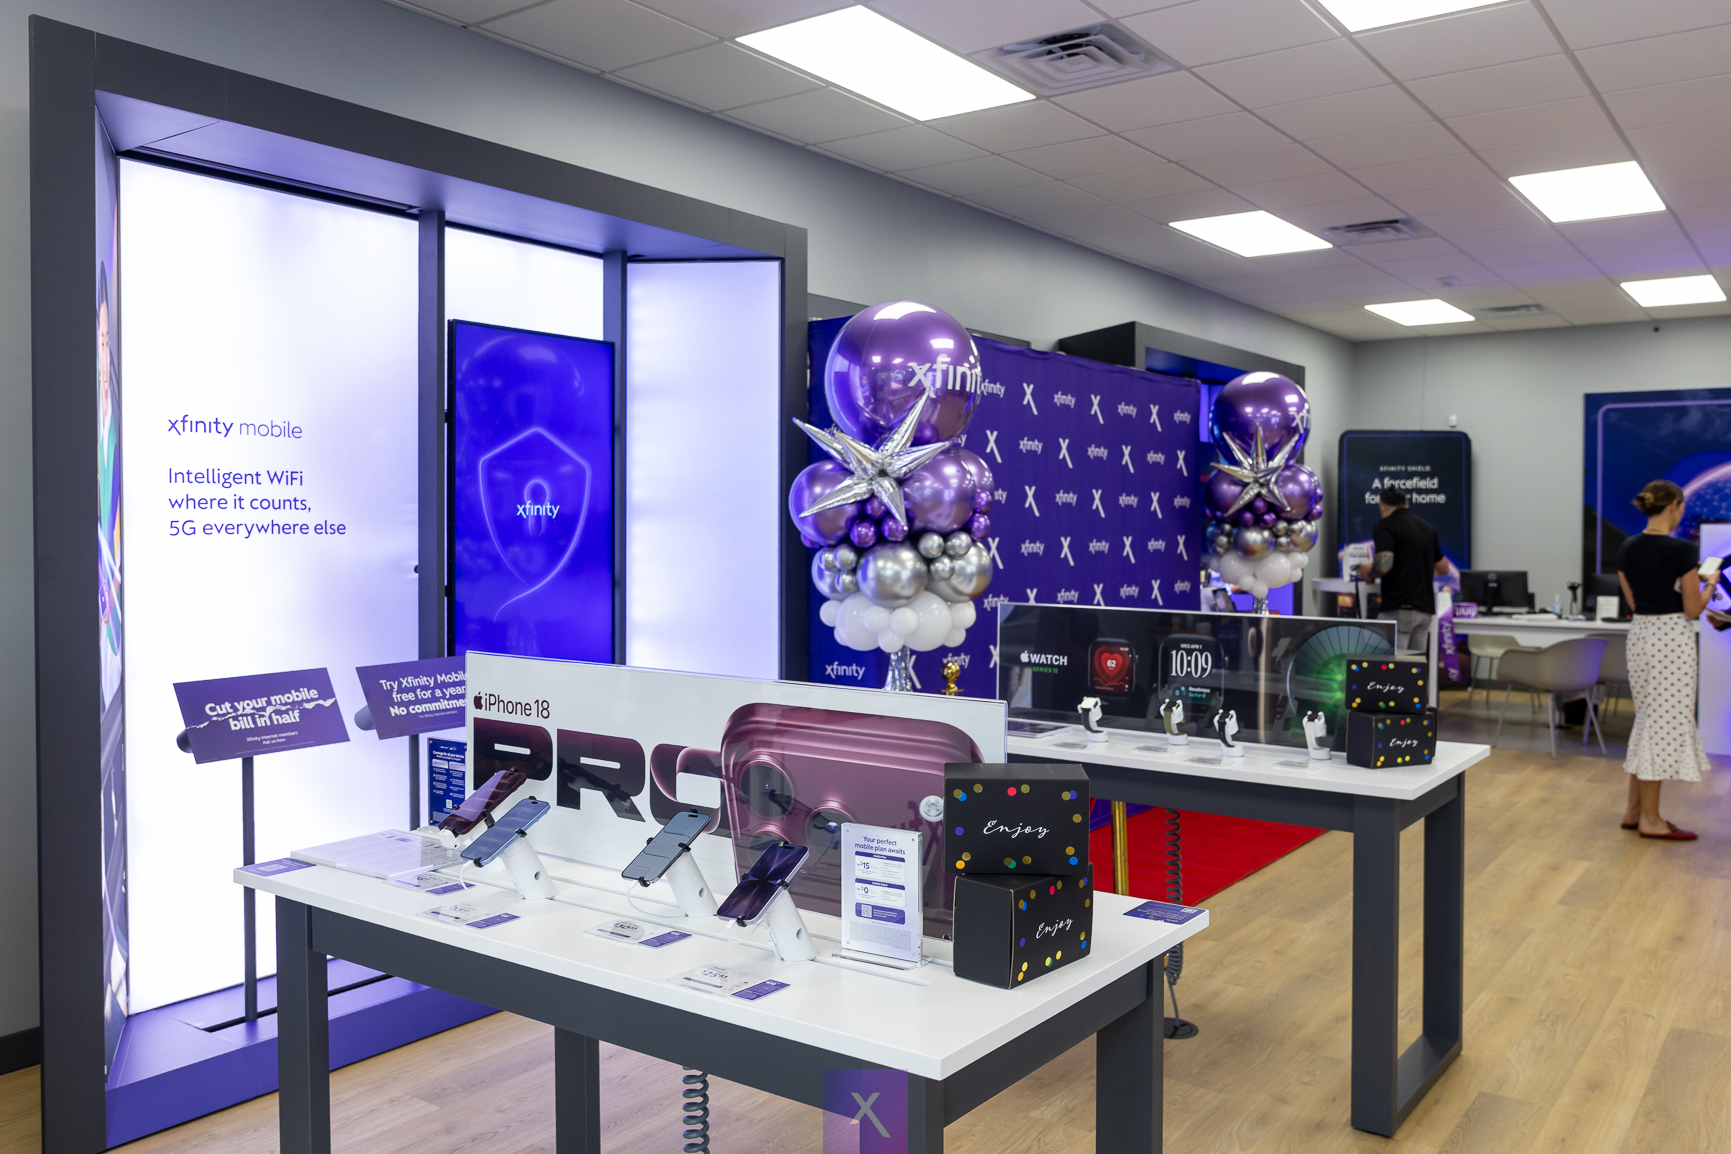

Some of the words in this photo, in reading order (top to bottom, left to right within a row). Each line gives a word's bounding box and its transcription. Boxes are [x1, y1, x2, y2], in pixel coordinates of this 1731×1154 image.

[906, 353, 982, 399] xfinit
[1053, 390, 1076, 409] xfinity
[1117, 402, 1137, 418] xfinity
[168, 414, 234, 438] xfinity
[239, 420, 303, 439] mobile
[1019, 436, 1043, 454] xfinity
[1087, 444, 1108, 460] xfinity
[1147, 450, 1165, 465] xfinity
[169, 468, 262, 488] Intelligent
[266, 470, 303, 486] WiFi
[1371, 477, 1382, 489] A
[168, 494, 228, 510] where
[233, 494, 245, 510] it
[249, 497, 311, 513] counts,
[1055, 490, 1078, 506] xfinity
[1119, 492, 1138, 508] xfinity
[1412, 491, 1446, 503] home
[516, 500, 560, 519] xfinity
[169, 520, 196, 536] 5G
[202, 519, 309, 539] everywhere
[314, 520, 346, 535] else
[1021, 539, 1045, 556] xfinity
[1088, 539, 1110, 554] xfinity
[1147, 538, 1166, 553] xfinity
[1057, 588, 1079, 604] xfinity
[1119, 584, 1139, 599] xfinity
[1030, 653, 1068, 666] WATCH
[1107, 659, 1116, 668] 62
[1170, 649, 1212, 679] 10:09
[825, 661, 866, 680] xfinity
[379, 680, 399, 692] Try
[400, 675, 434, 688] Xfinity
[1367, 681, 1404, 693] Enjoy
[205, 702, 233, 716] Cut
[233, 700, 268, 713] your
[270, 688, 319, 705] mobile
[393, 691, 416, 703] free
[416, 688, 432, 700] for
[435, 689, 443, 697] a
[389, 705, 408, 717] No
[409, 698, 467, 714] commitme
[484, 694, 532, 717] iPhone
[534, 700, 550, 719] 18
[229, 717, 256, 731] bill
[255, 714, 270, 728] in
[271, 709, 301, 725] half
[1389, 737, 1418, 748] Enjoy
[983, 819, 1049, 838] Enjoy
[855, 843, 874, 851] mobile
[1035, 917, 1073, 939] Enjoy
